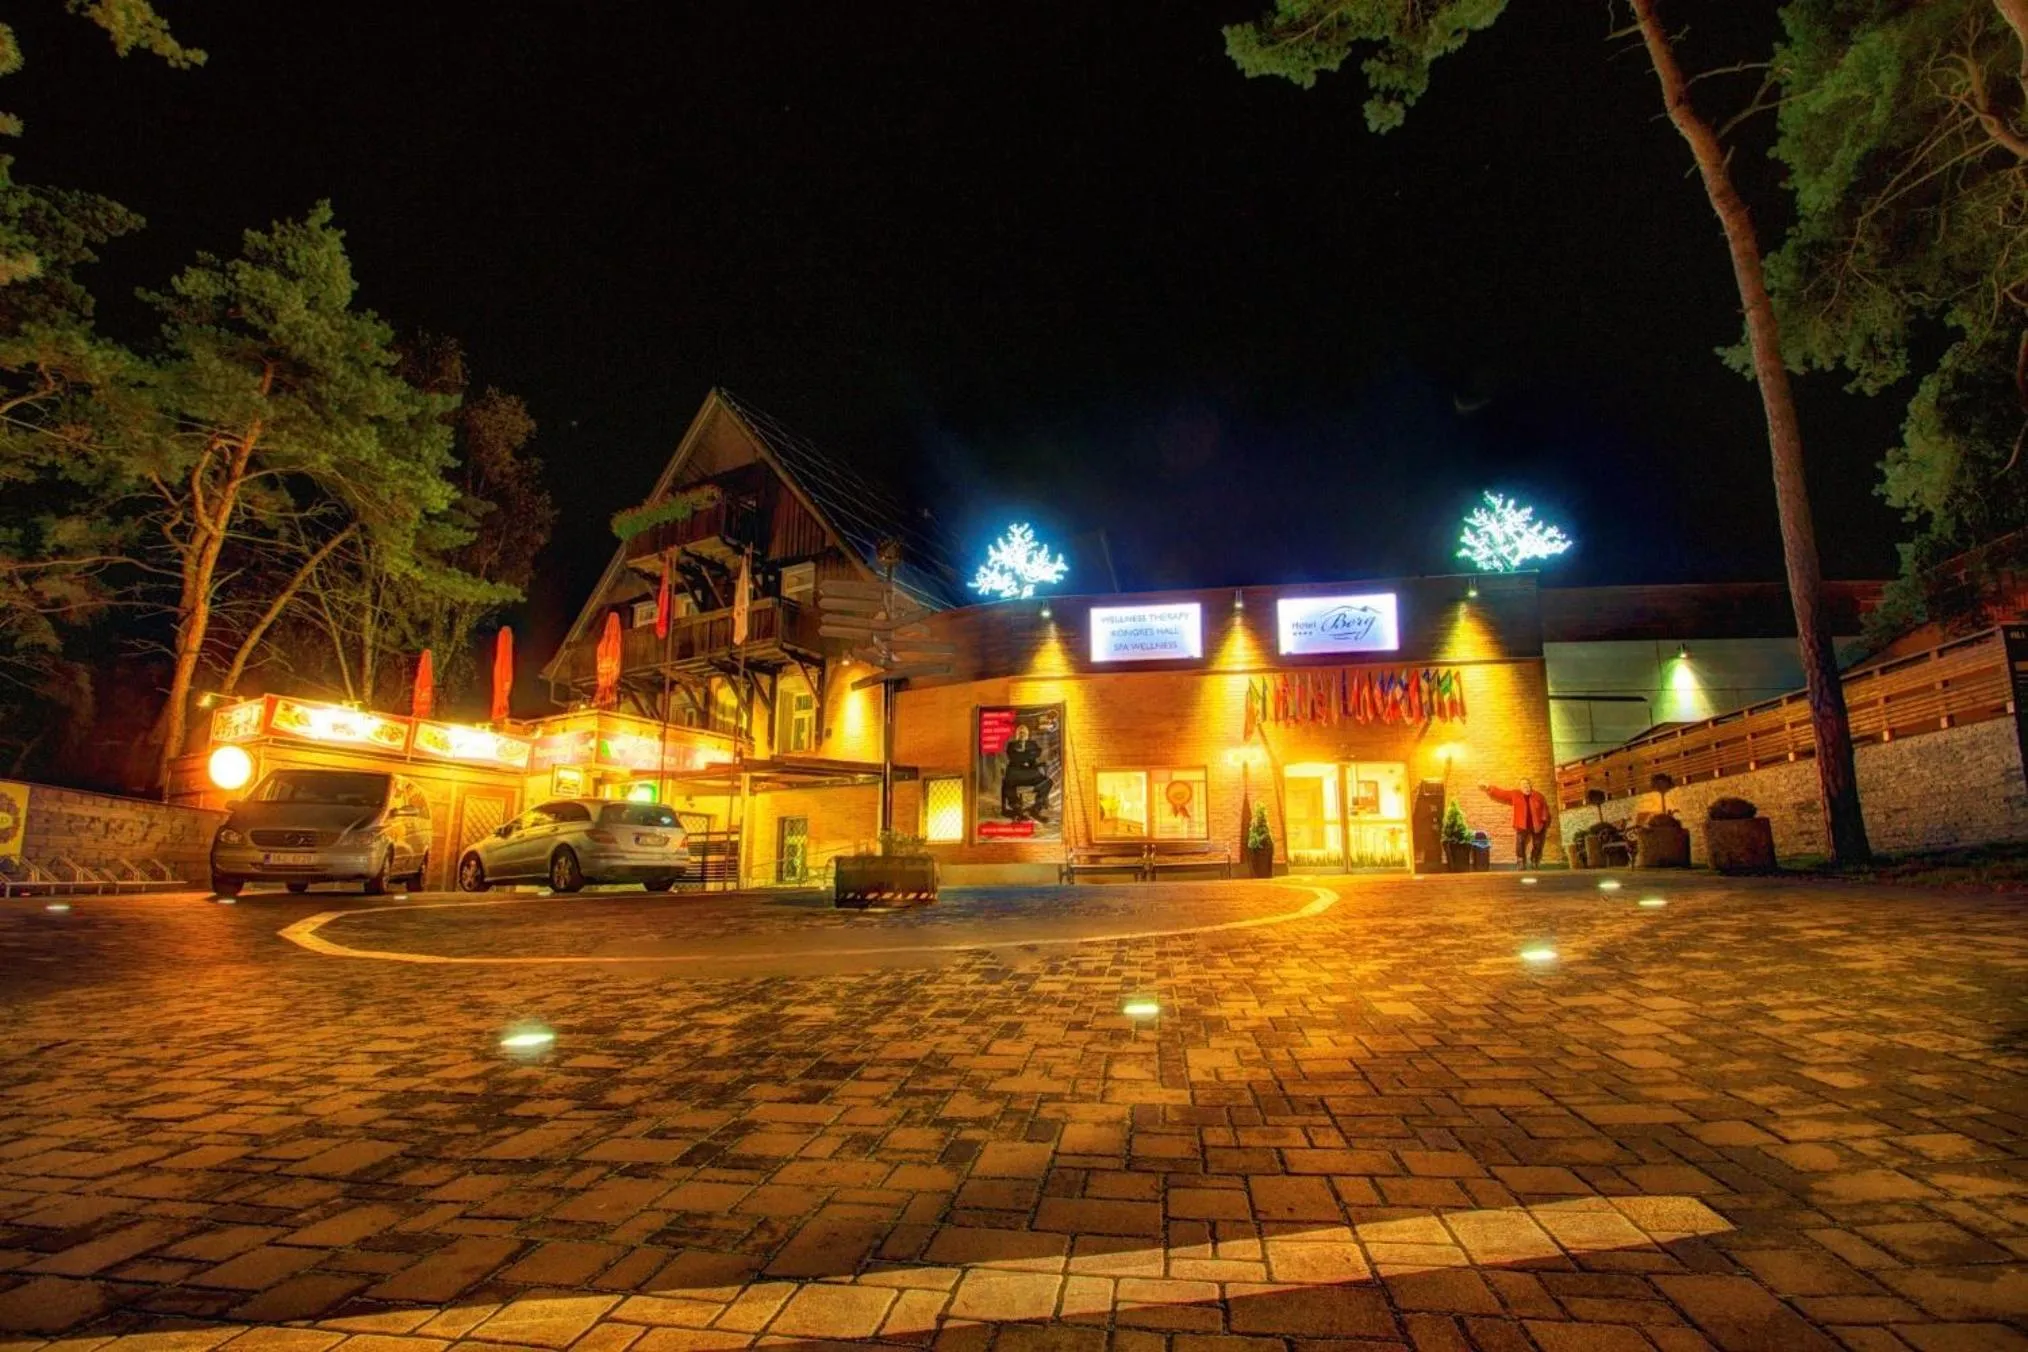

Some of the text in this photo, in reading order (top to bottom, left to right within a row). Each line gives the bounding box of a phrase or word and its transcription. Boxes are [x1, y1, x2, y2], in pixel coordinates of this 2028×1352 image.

[1101, 611, 1190, 625] WELLNESS THERAPY
[1111, 624, 1180, 637] KONGRES HALL
[1292, 620, 1317, 630] Hotel
[1113, 640, 1178, 652] SPA WELLNESS
